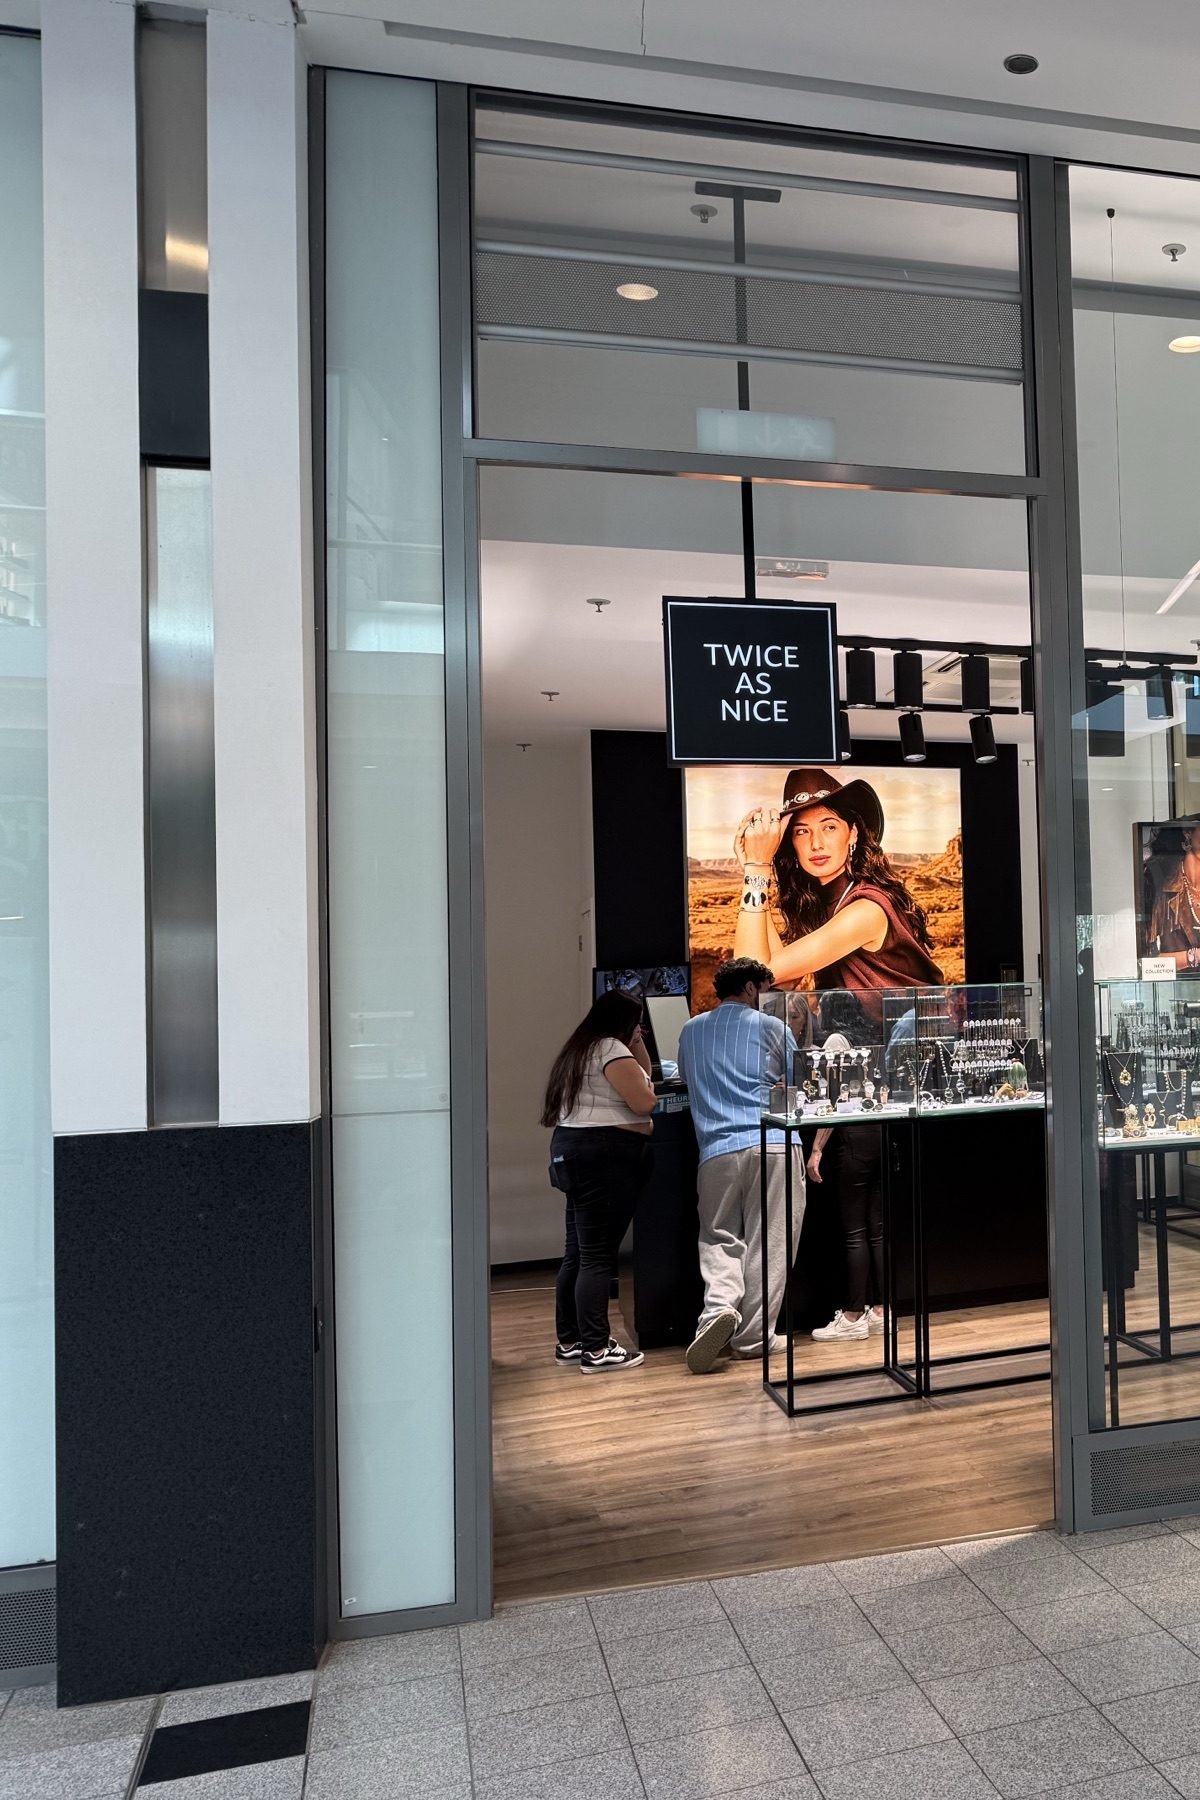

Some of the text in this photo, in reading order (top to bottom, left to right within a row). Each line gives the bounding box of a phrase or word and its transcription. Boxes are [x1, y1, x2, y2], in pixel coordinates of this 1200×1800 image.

[703, 643, 800, 668] TWICE
[734, 672, 772, 695] AS
[721, 699, 789, 722] NICE
[667, 1095, 691, 1105] HEUR
